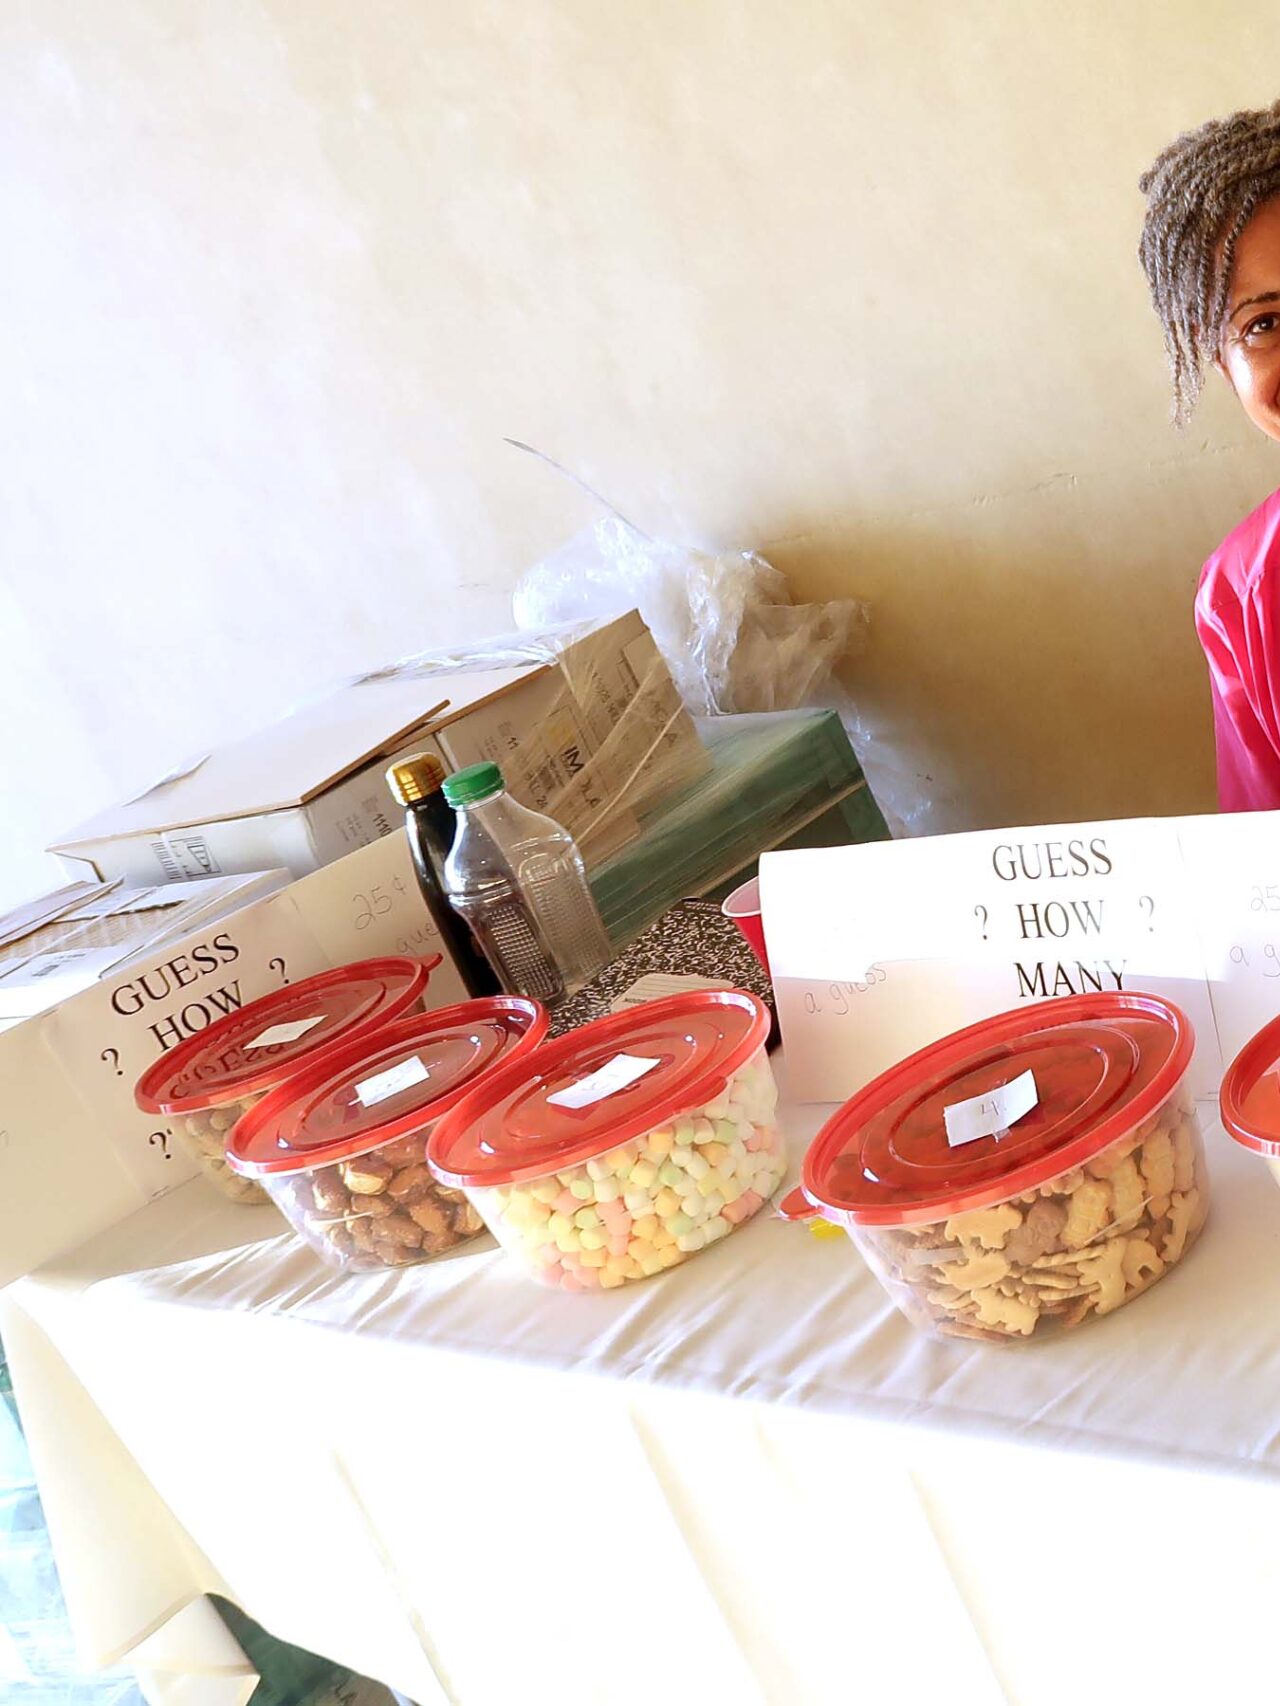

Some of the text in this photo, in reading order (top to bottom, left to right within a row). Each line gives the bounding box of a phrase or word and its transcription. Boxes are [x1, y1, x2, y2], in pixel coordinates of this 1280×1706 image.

[992, 837, 1113, 881] GUESS
[974, 895, 1155, 941] ? HOW ?
[110, 932, 241, 1016] GUESS
[1012, 959, 1128, 998] MANY
[101, 956, 291, 1076] ? HOW ?
